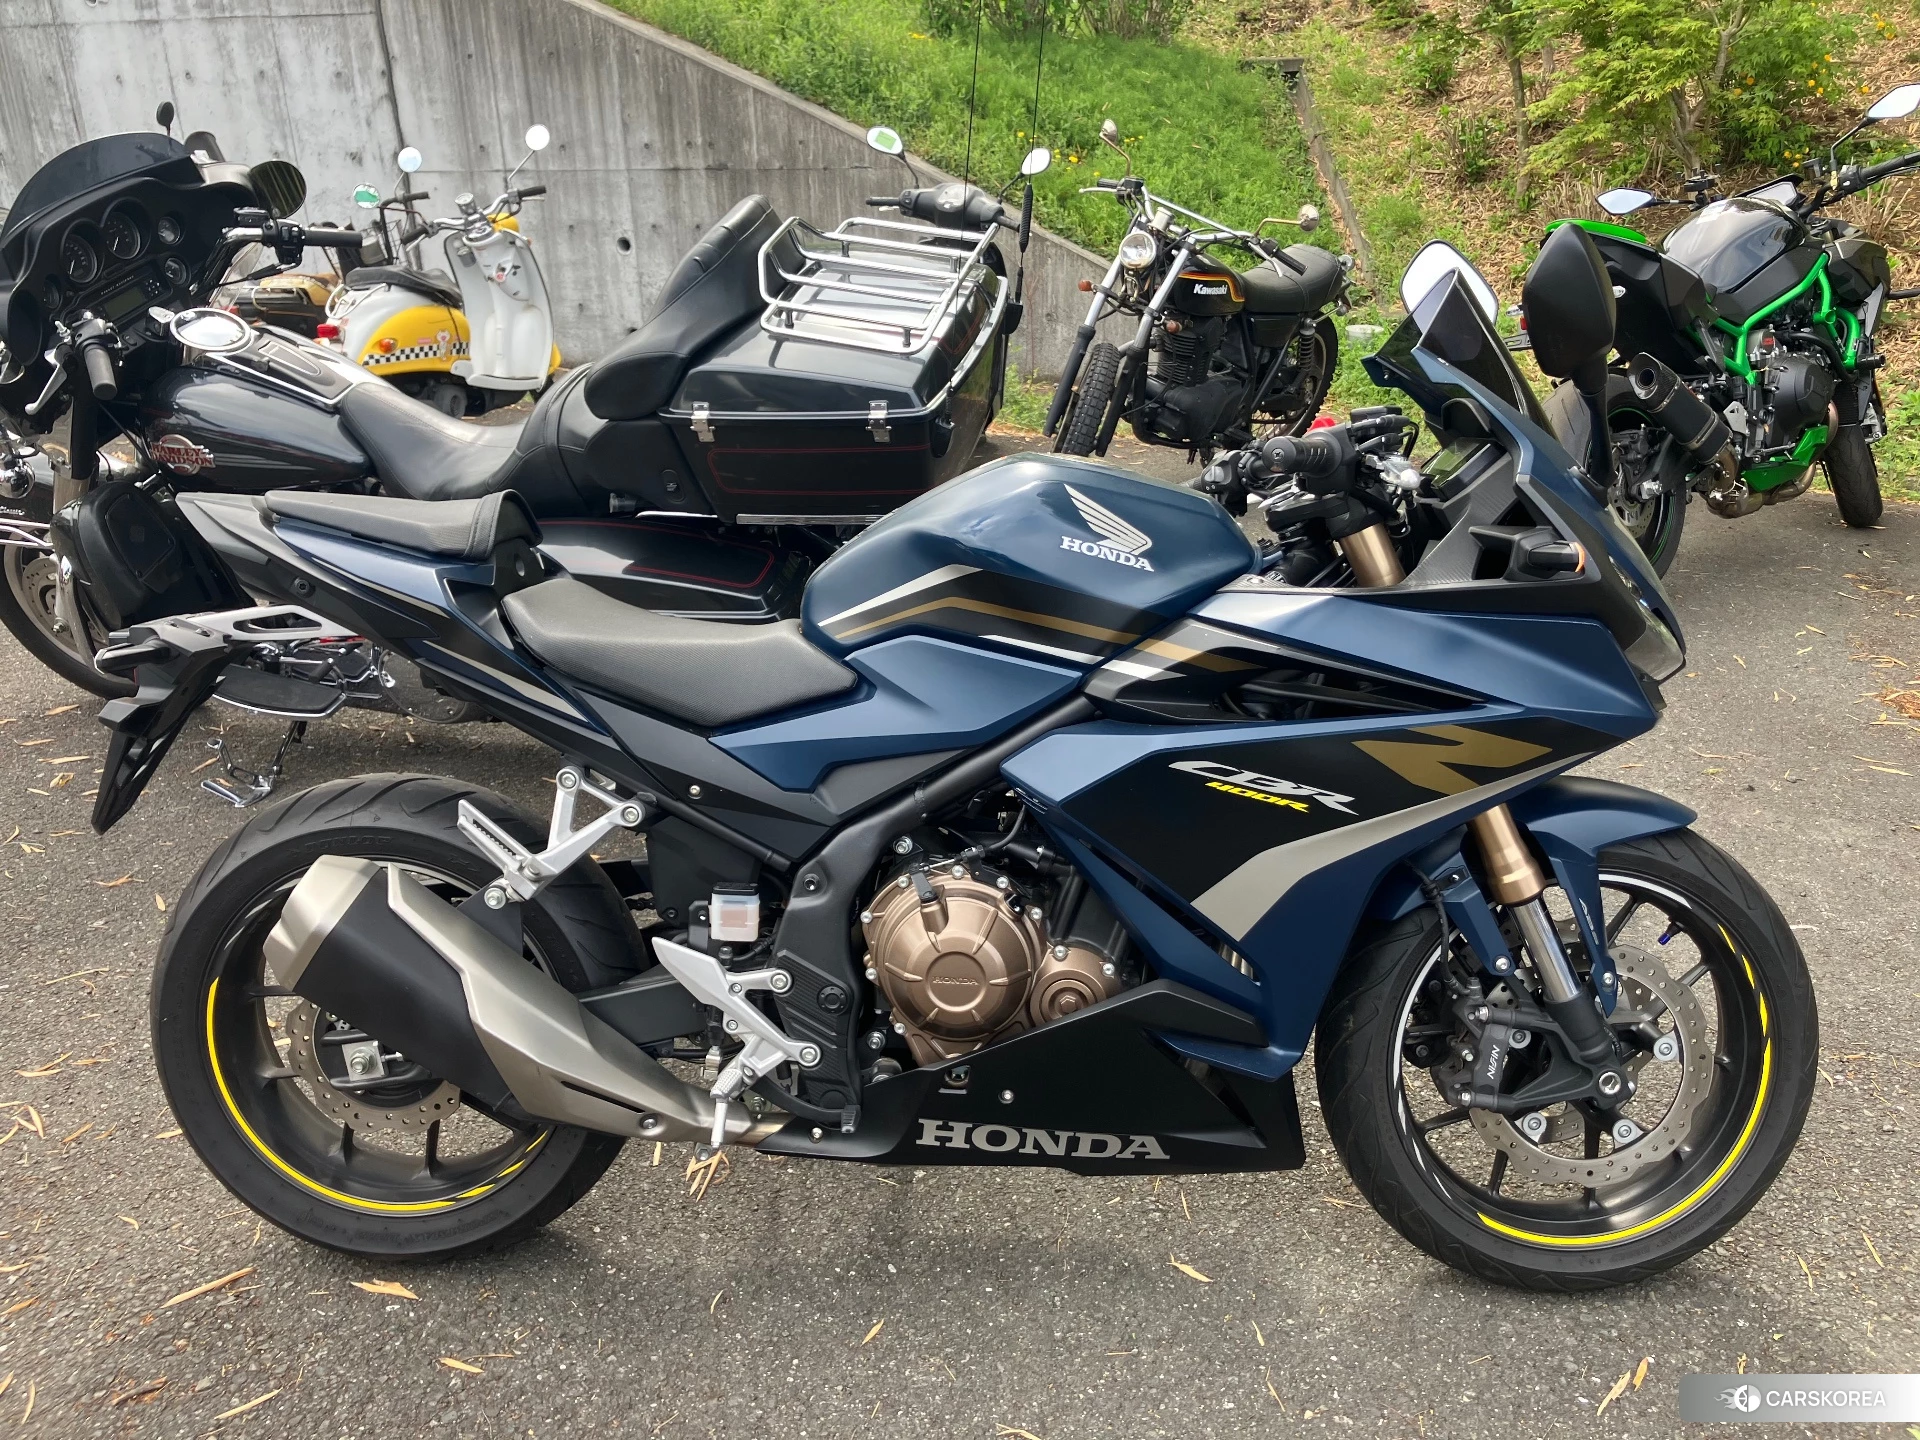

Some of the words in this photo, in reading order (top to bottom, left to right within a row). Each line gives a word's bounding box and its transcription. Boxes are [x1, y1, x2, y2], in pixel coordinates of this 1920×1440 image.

[1193, 283, 1228, 295] Kawasaki
[1059, 536, 1155, 572] HONDA
[1168, 761, 1360, 816] CBR
[1205, 781, 1310, 813] 400R
[932, 976, 979, 986] HONDA
[915, 1118, 1171, 1160] HONDA
